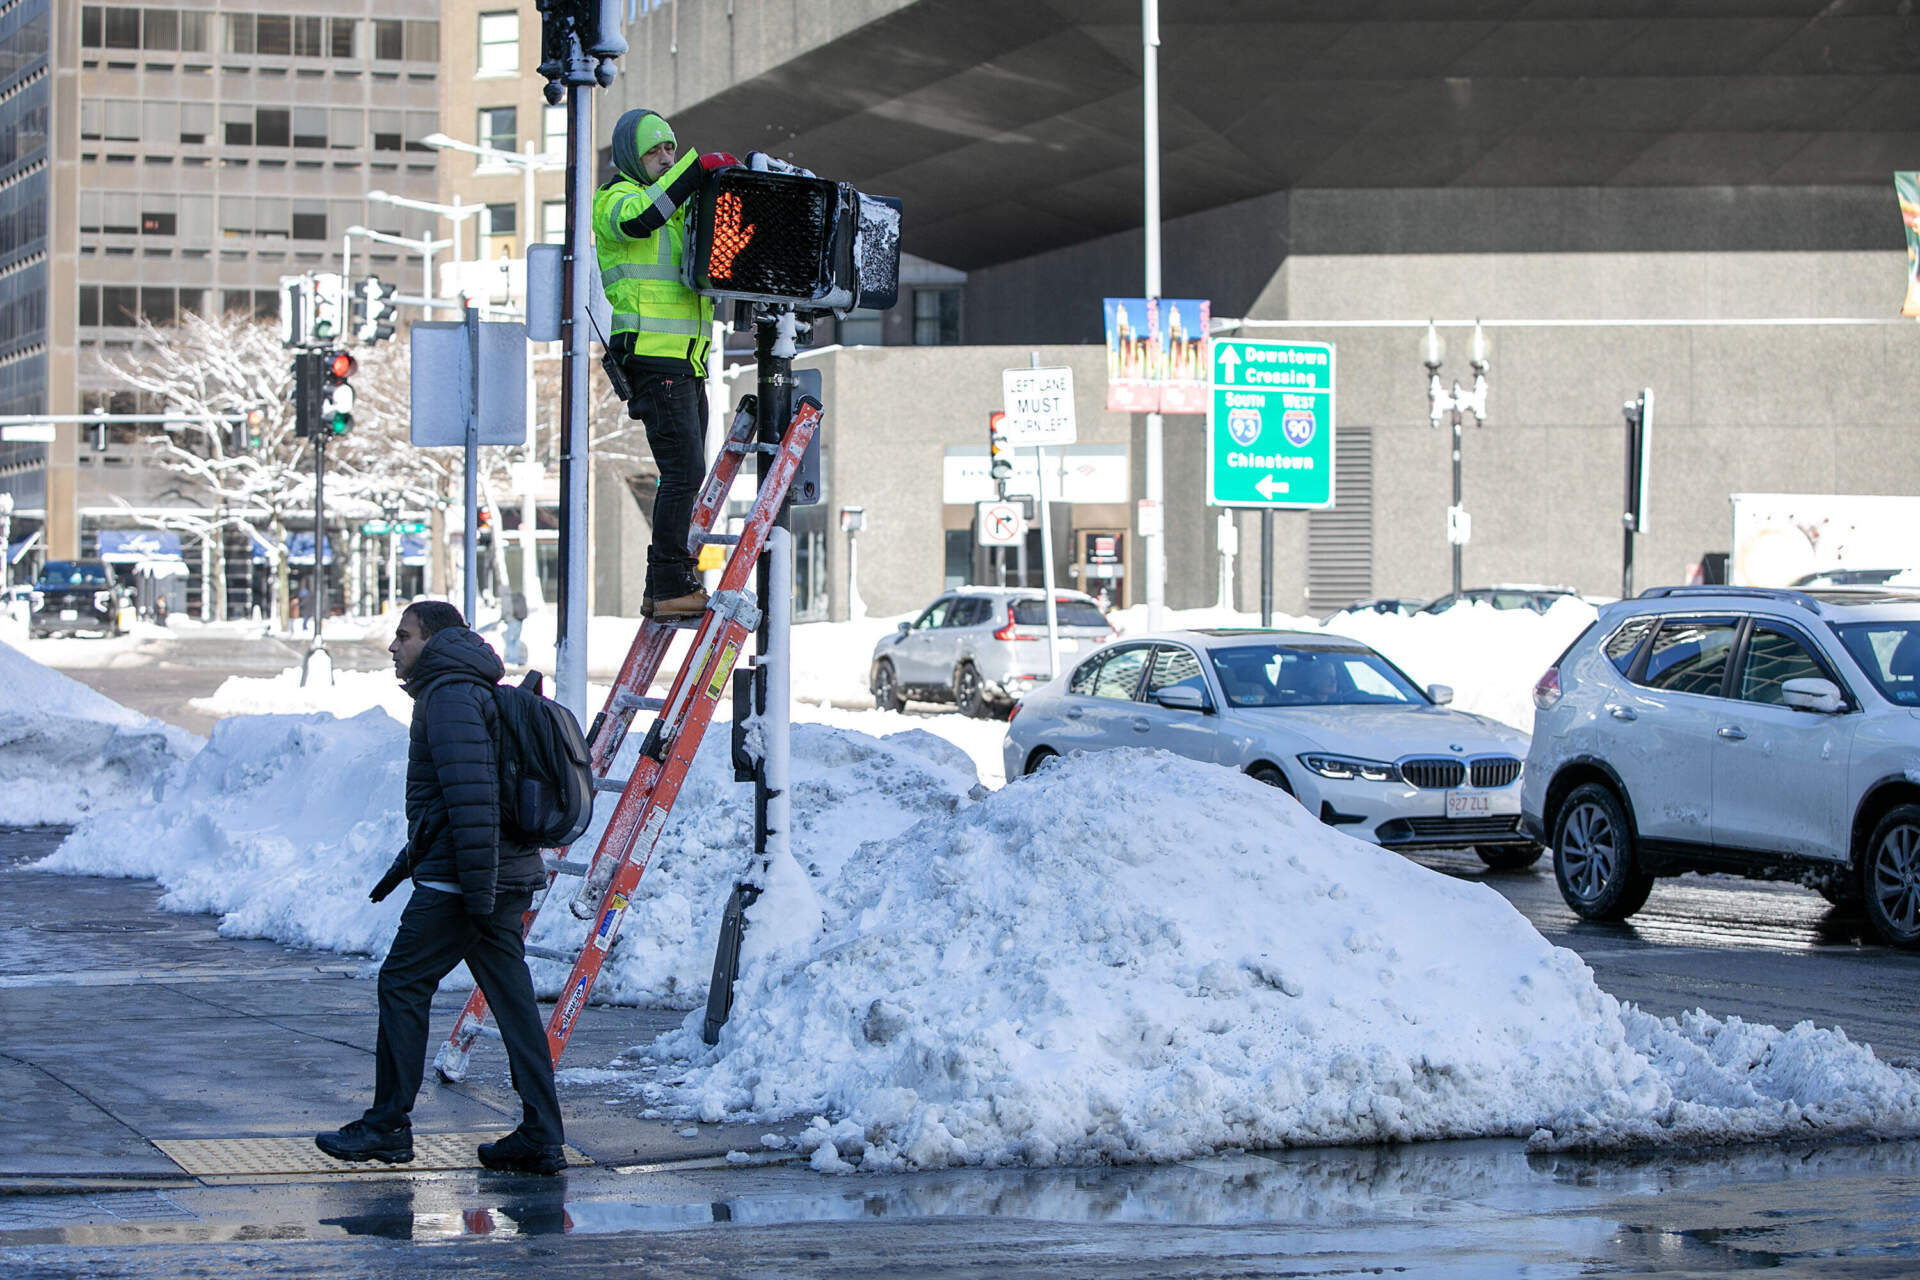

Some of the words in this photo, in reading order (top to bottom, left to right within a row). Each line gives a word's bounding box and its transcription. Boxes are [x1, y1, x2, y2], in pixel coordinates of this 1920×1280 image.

[1245, 346, 1328, 366] Downtown
[1011, 379, 1035, 393] LEFT
[1040, 377, 1066, 391] LANE
[1245, 367, 1317, 388] Crossing
[1018, 397, 1060, 413] MUST
[1225, 391, 1265, 408] SOUTH
[1283, 393, 1316, 409] WEST
[1233, 419, 1257, 438] 93
[1287, 419, 1310, 440] 90
[1227, 452, 1314, 470] Chinatown
[1448, 798, 1467, 811] 927
